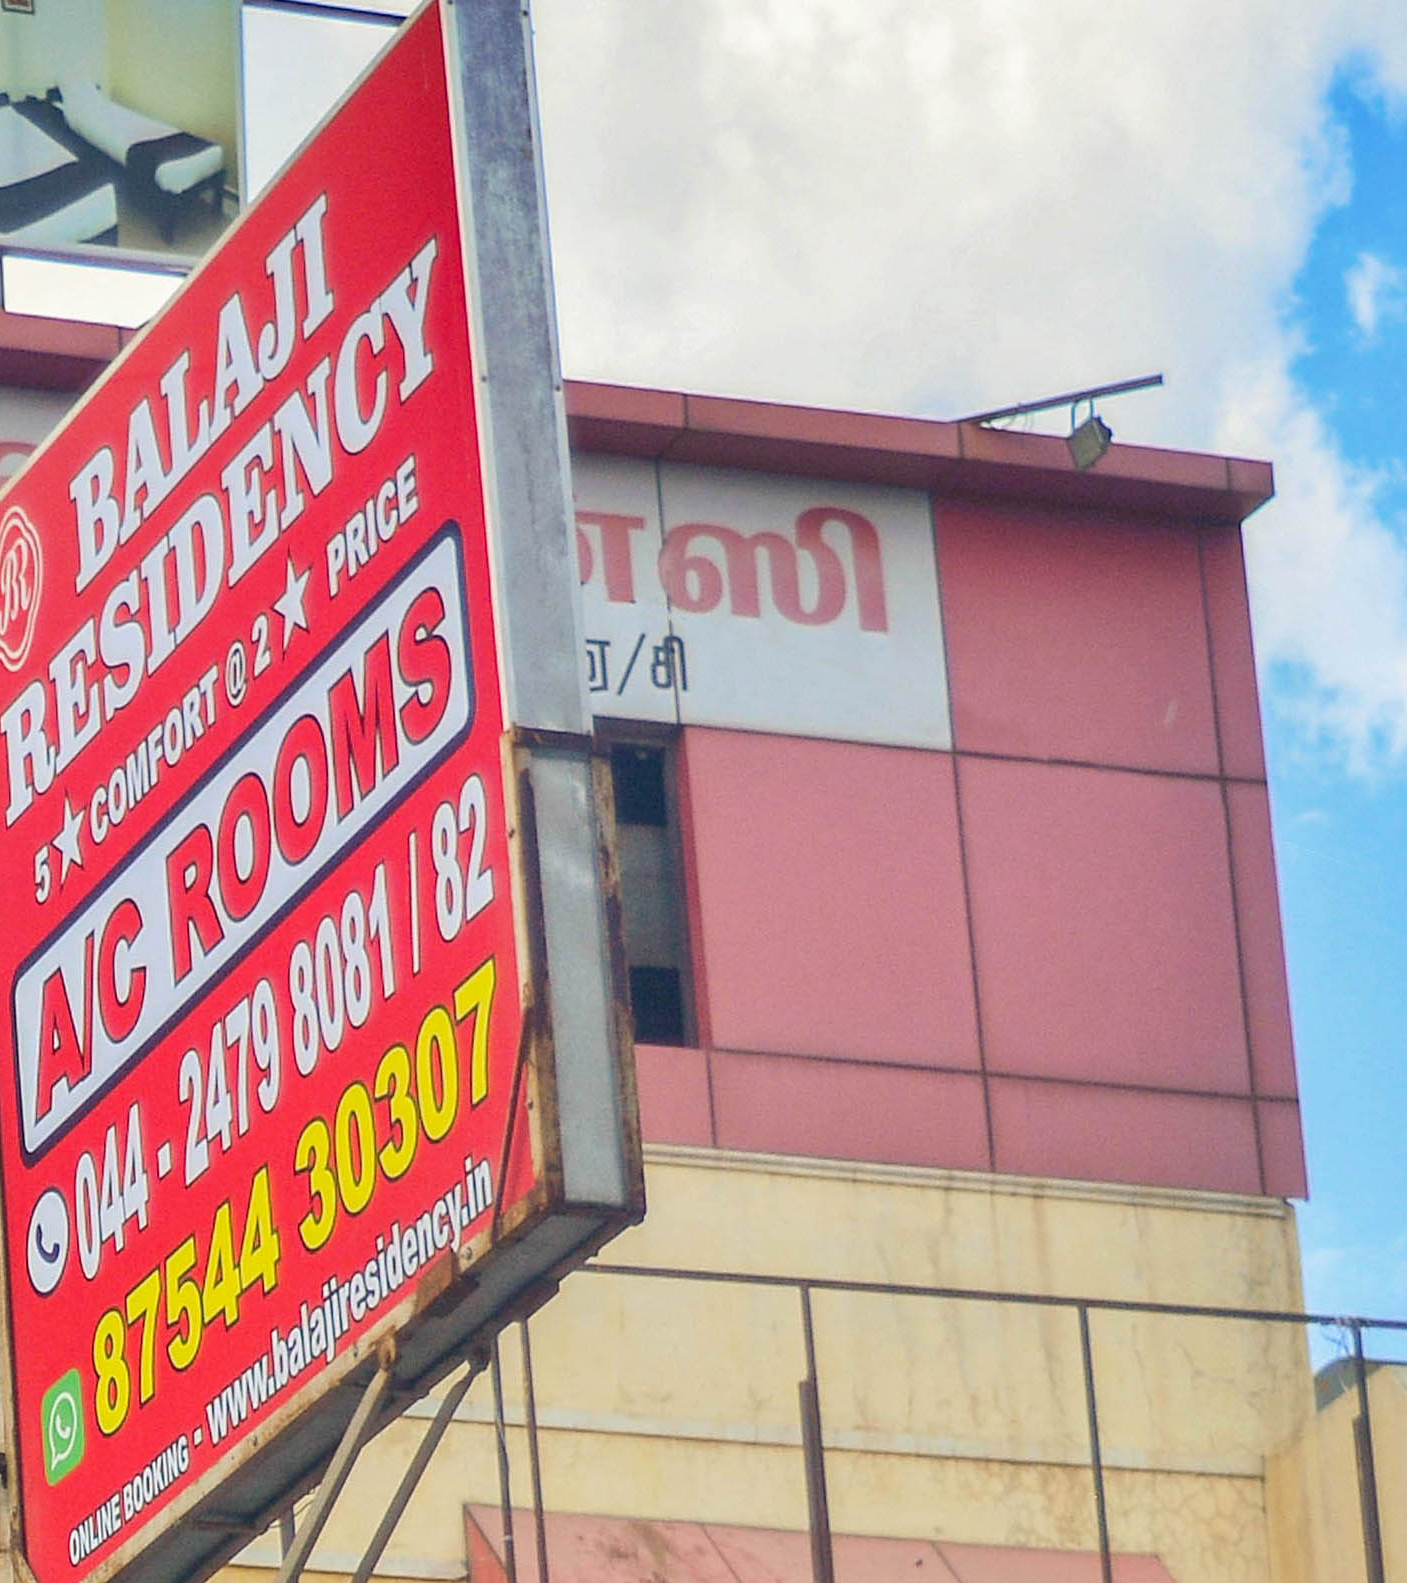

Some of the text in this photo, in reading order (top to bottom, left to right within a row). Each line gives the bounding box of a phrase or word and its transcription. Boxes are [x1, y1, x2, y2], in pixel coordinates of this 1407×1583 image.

[68, 191, 335, 596] BALAJI
[35, 585, 454, 1124] A/C ROOMS
[89, 672, 219, 846] COMFORT
[224, 640, 247, 709] @
[325, 452, 420, 598] PRICE
[74, 1102, 151, 1282] 044
[177, 977, 282, 1190] 2479
[289, 861, 397, 1078] 8081
[430, 772, 496, 943] 82
[90, 957, 498, 1437] 87544 30307
[67, 1487, 122, 1566] ONLINE
[122, 1429, 190, 1520] BOOKING
[205, 1156, 495, 1446] www.balajiresidency.in
